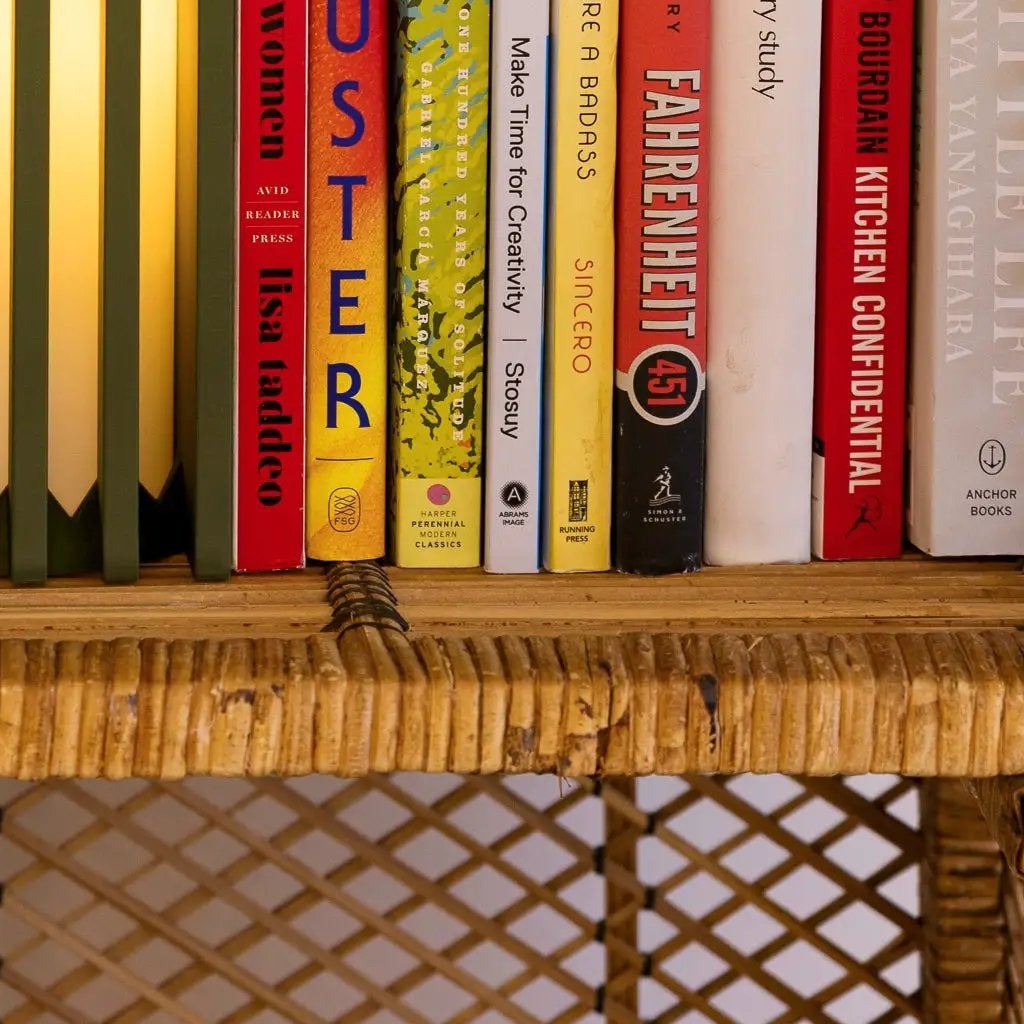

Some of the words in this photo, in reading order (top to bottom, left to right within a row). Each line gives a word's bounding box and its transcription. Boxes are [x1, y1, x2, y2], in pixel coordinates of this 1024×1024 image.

[458, 8, 471, 53] ONE
[580, 46, 600, 62] A
[752, 30, 785, 100] study
[259, 1, 286, 159] women
[510, 37, 531, 98] Make
[855, 12, 892, 155] BOURDAIN
[420, 61, 434, 164] GABRIEL
[456, 67, 469, 180] HUNDRED
[509, 104, 531, 159] Time
[576, 76, 599, 180] BADASS
[246, 210, 300, 221] READER
[256, 186, 289, 196] AVID
[508, 166, 530, 198] for
[639, 69, 701, 339] FAHRENHEIT
[252, 234, 294, 243] PRESS
[455, 193, 468, 268] YEARS
[502, 205, 529, 315] Creativity
[853, 166, 888, 284] KITCHEN
[945, 93, 976, 363] YANAGIHARA
[259, 268, 293, 344] lisa
[454, 282, 466, 309] OF
[572, 258, 594, 374] SINCERO
[452, 323, 466, 441] SOLITUDE
[501, 362, 526, 440] Stosuy
[647, 358, 688, 407] 451
[848, 295, 887, 495] CONFIDENTIAL
[257, 359, 292, 507] taddeo
[334, 517, 355, 526] FSG
[966, 489, 1017, 500] ANCHOR
[970, 505, 1013, 517] BOOKS
[415, 541, 462, 549] CLASSICS
[559, 526, 596, 534] RUNNING
[565, 535, 589, 543] PRESS
